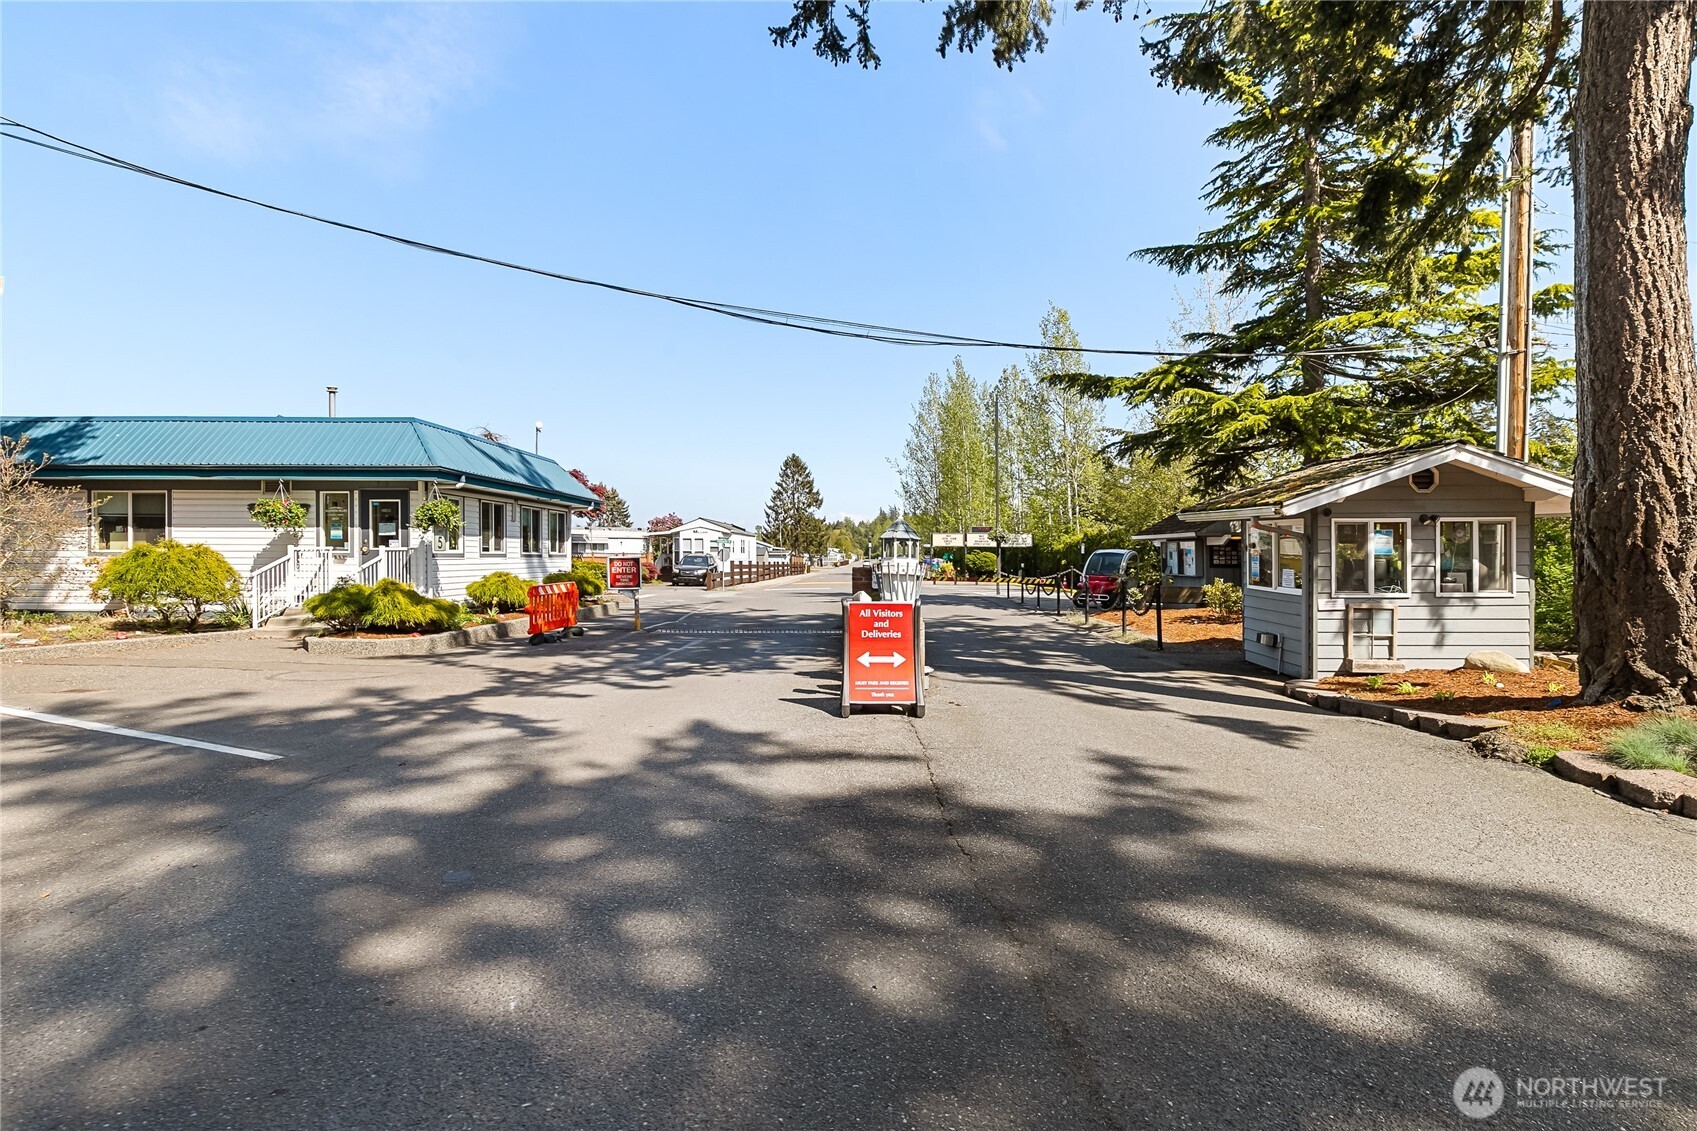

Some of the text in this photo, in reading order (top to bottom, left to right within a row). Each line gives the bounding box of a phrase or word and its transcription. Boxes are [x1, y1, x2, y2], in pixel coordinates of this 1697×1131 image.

[437, 536, 443, 549] 5
[859, 608, 903, 618] All Visitors
[873, 619, 889, 628] and
[861, 629, 902, 638] Deliveries
